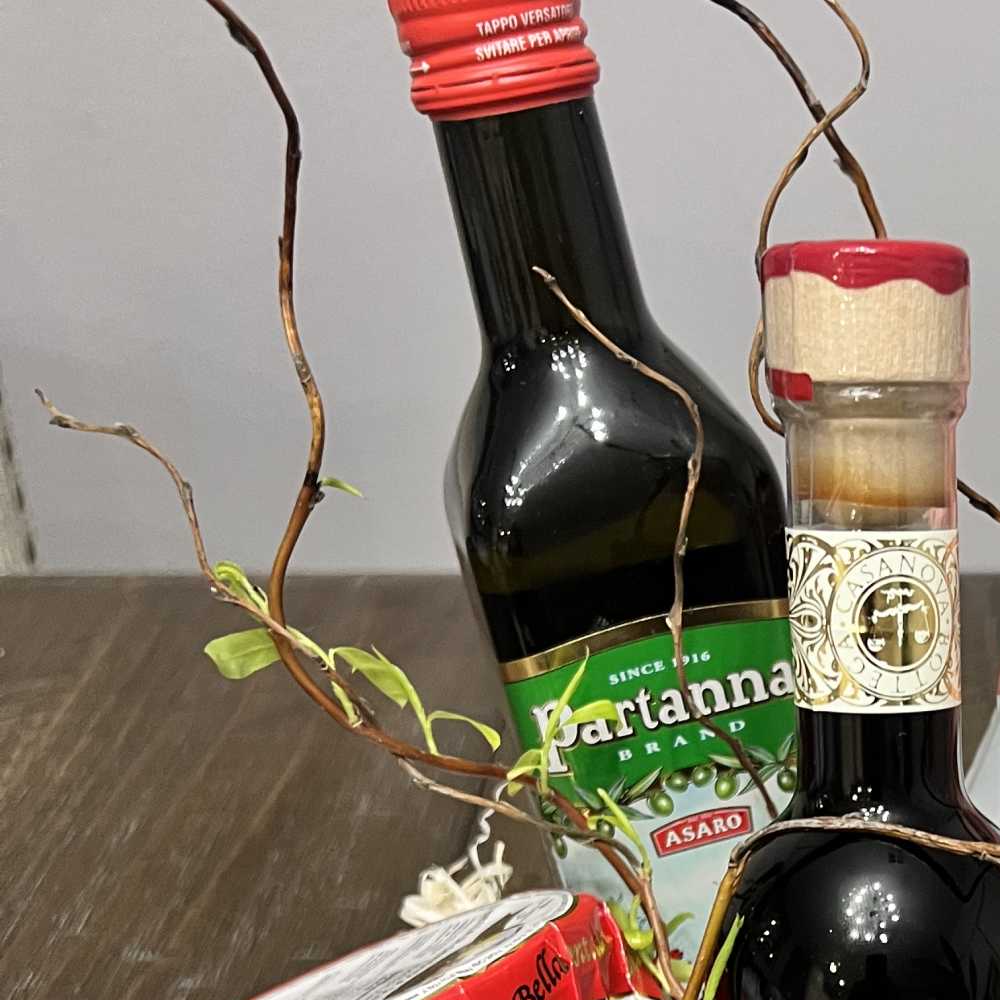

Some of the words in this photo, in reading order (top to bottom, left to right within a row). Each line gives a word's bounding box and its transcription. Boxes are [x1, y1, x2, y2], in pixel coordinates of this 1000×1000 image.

[476, 15, 518, 37] TAPPO
[475, 35, 527, 61] SVITARE
[528, 31, 553, 49] PER
[835, 554, 950, 614] CASANOVA
[609, 660, 665, 685] SINCE
[672, 651, 711, 669] 1916
[618, 720, 746, 762] BRAND
[664, 812, 743, 848] ASARO
